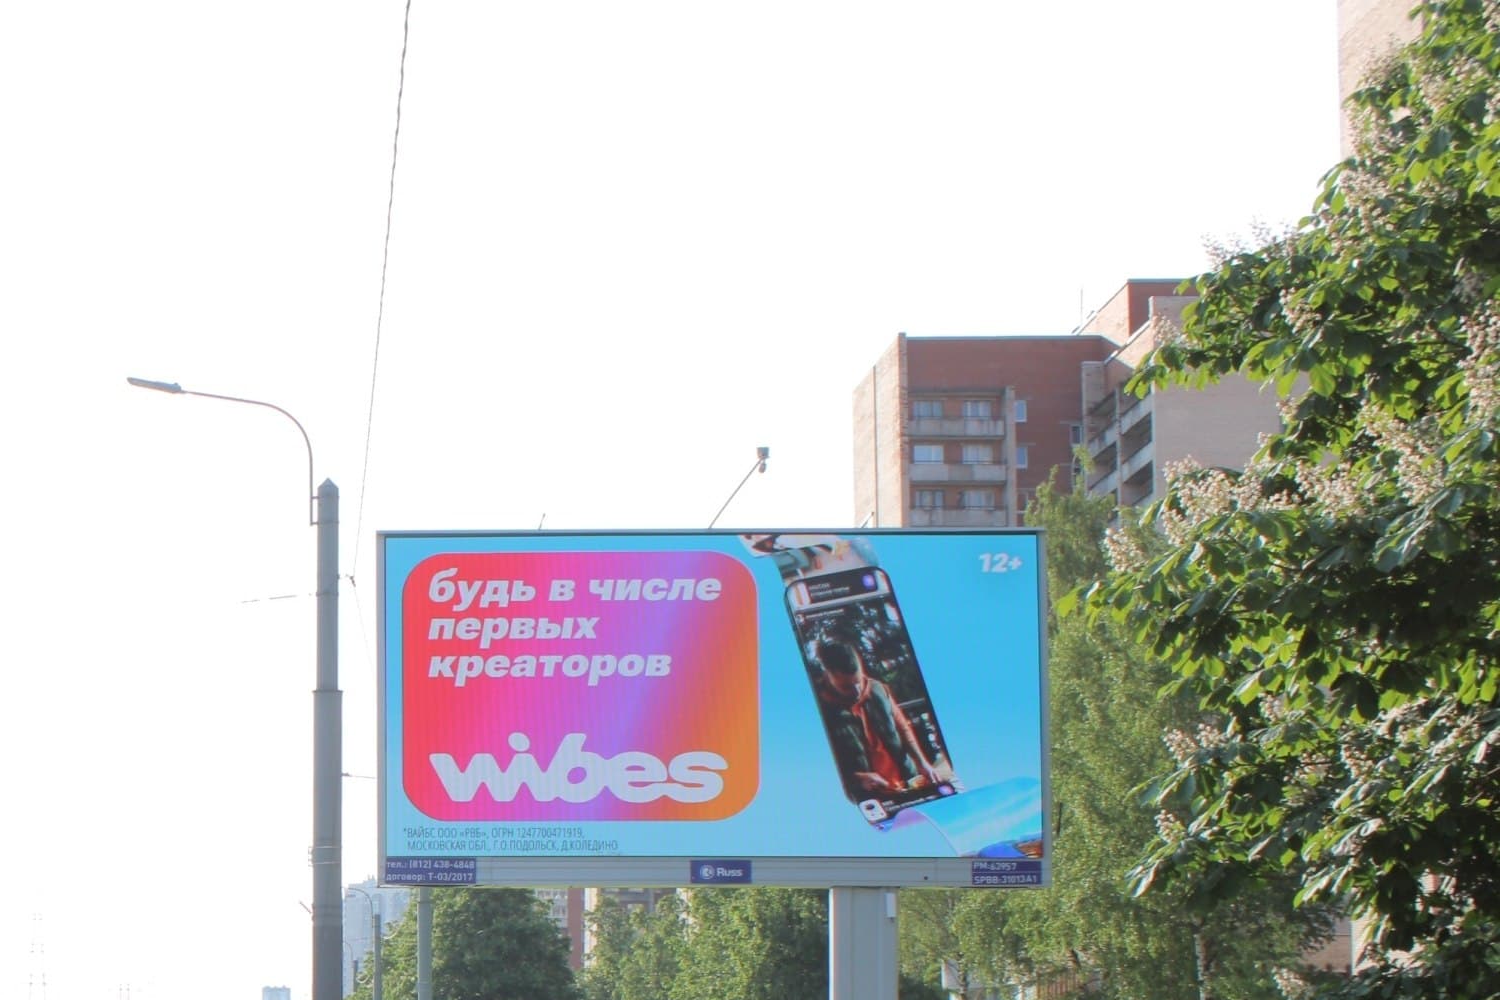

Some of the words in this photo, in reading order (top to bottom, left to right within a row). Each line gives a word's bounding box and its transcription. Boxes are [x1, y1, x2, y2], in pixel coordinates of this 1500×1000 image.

[978, 552, 1023, 573] 12+
[428, 567, 537, 612] будь
[548, 579, 576, 601] в
[589, 577, 722, 601] числе
[428, 616, 599, 649] первых
[428, 653, 672, 687] креаторов
[429, 732, 729, 803] wibes
[437, 827, 457, 838] ООО
[492, 827, 514, 838] ОГРН
[717, 867, 743, 877] Russ
